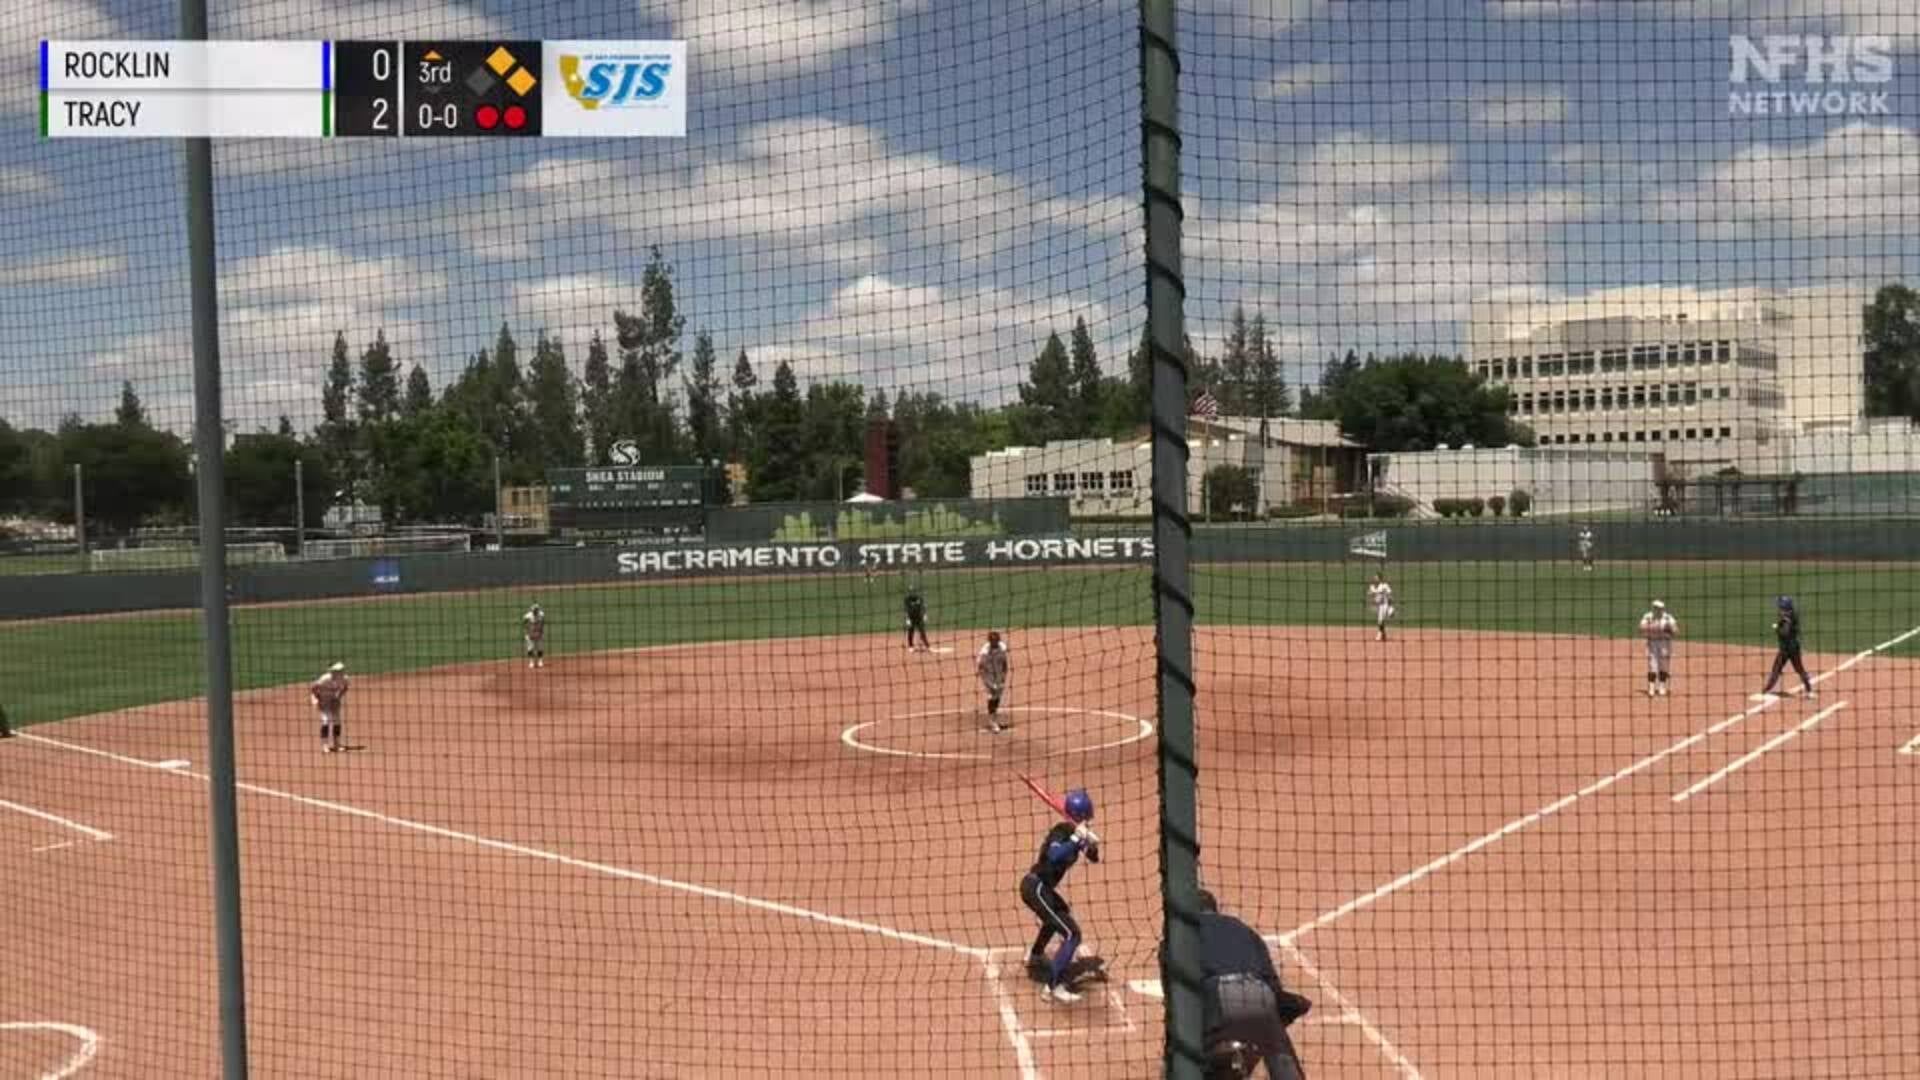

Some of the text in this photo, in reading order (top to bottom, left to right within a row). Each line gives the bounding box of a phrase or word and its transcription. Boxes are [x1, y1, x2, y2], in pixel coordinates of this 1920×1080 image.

[585, 470, 665, 483] SHEA STADIUM
[617, 537, 1155, 573] SACRAMENTO STATE HORNETS
